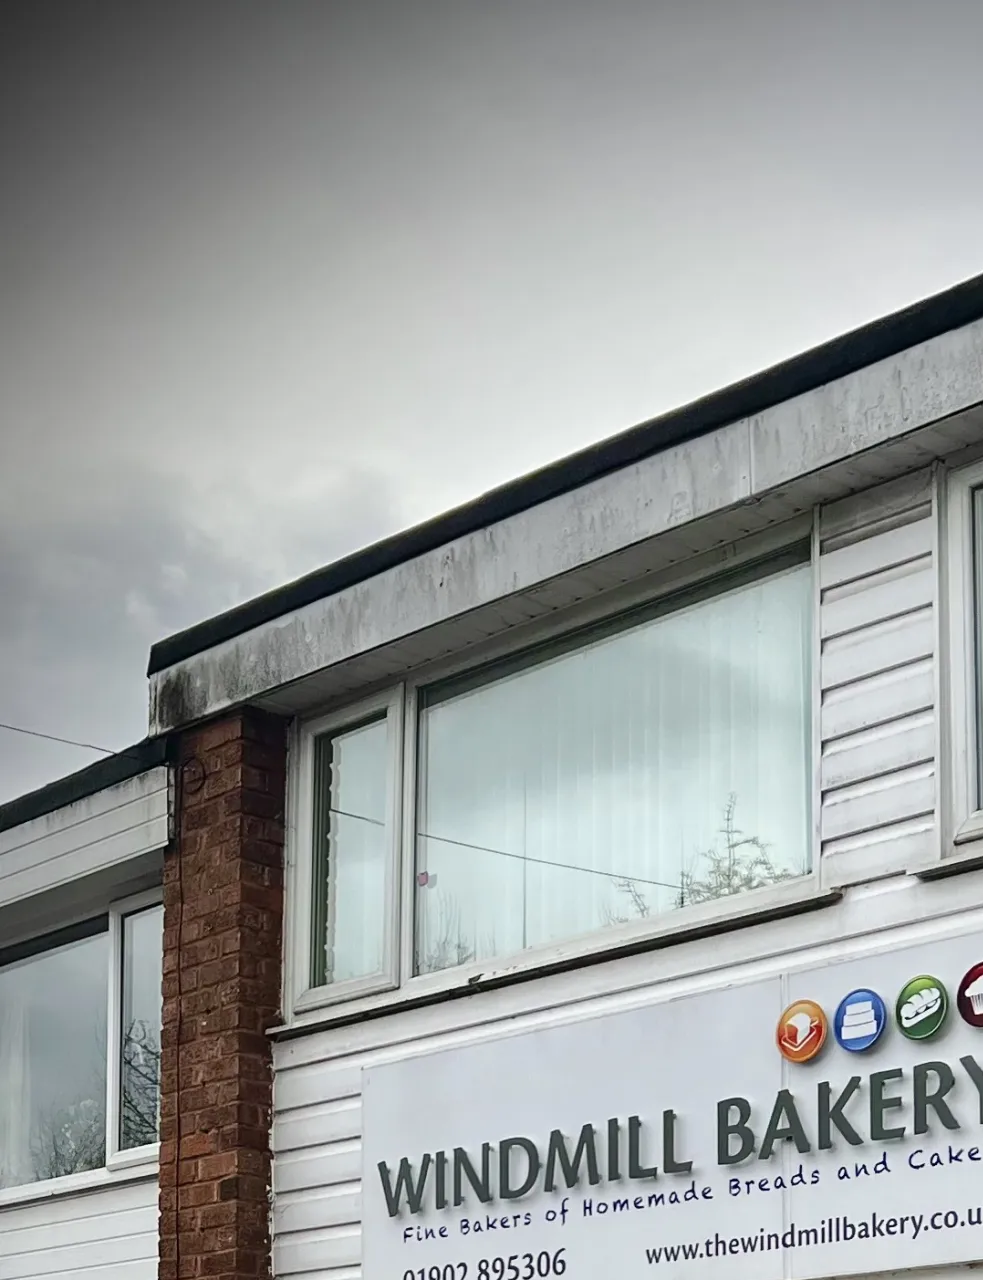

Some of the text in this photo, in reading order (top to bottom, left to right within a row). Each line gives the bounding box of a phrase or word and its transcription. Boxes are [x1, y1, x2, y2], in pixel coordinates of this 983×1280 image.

[377, 1109, 693, 1218] WINDMILL
[403, 1224, 449, 1243] Fine
[460, 1212, 532, 1236] Bakers
[545, 1198, 569, 1225] of
[583, 1180, 714, 1217] Homemade
[728, 1165, 821, 1197] Breads
[837, 1152, 892, 1181] and
